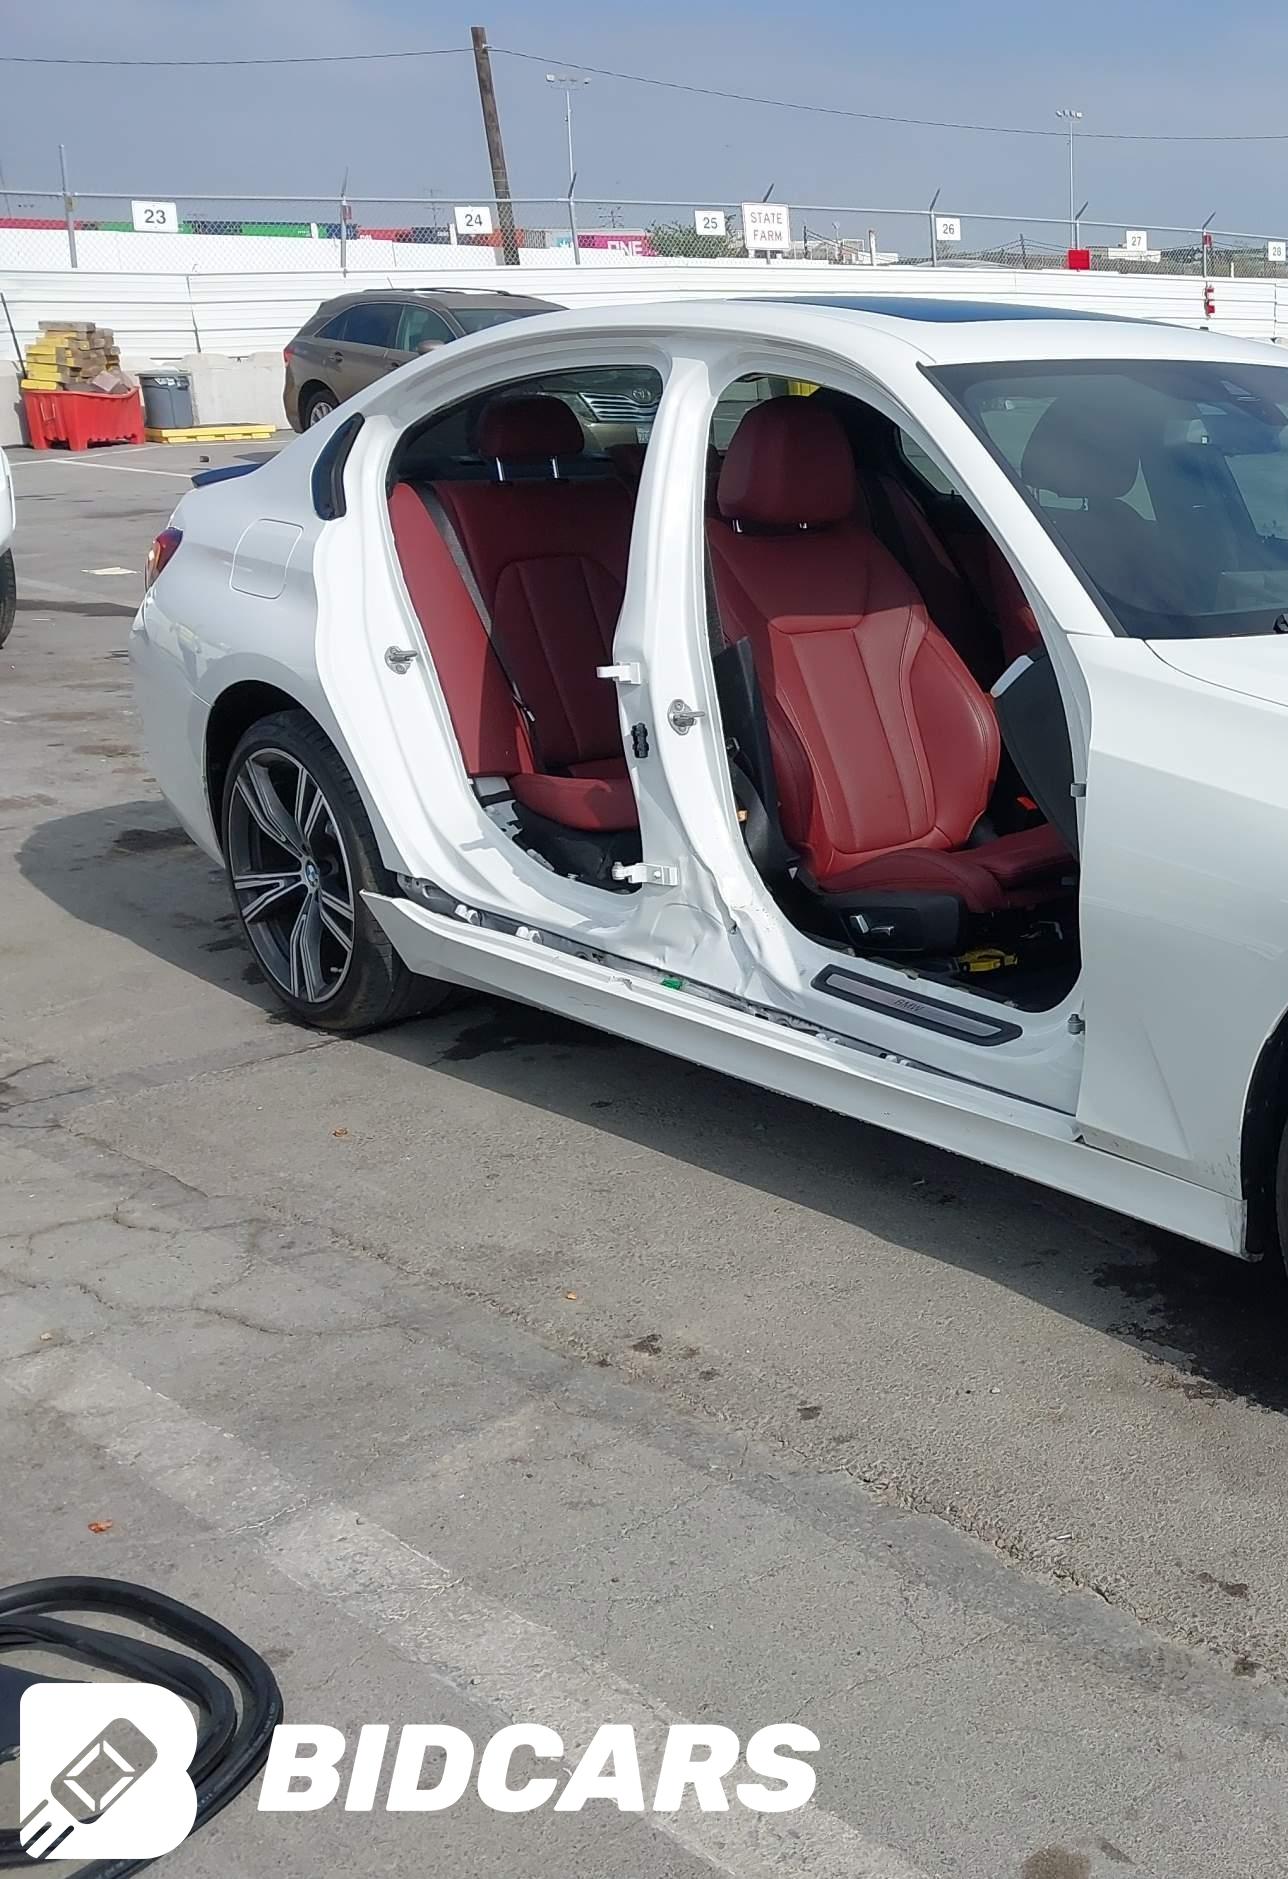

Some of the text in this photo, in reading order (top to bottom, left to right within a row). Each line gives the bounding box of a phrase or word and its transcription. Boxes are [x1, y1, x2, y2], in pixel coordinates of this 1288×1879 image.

[144, 209, 167, 225] 23
[464, 213, 483, 227] 24
[703, 216, 718, 229] 25
[750, 211, 783, 224] STATE
[753, 229, 783, 241] FARM
[942, 223, 955, 235] 26
[1131, 236, 1142, 247] 27
[1272, 246, 1282, 257] 28
[893, 998, 925, 1012] BMW
